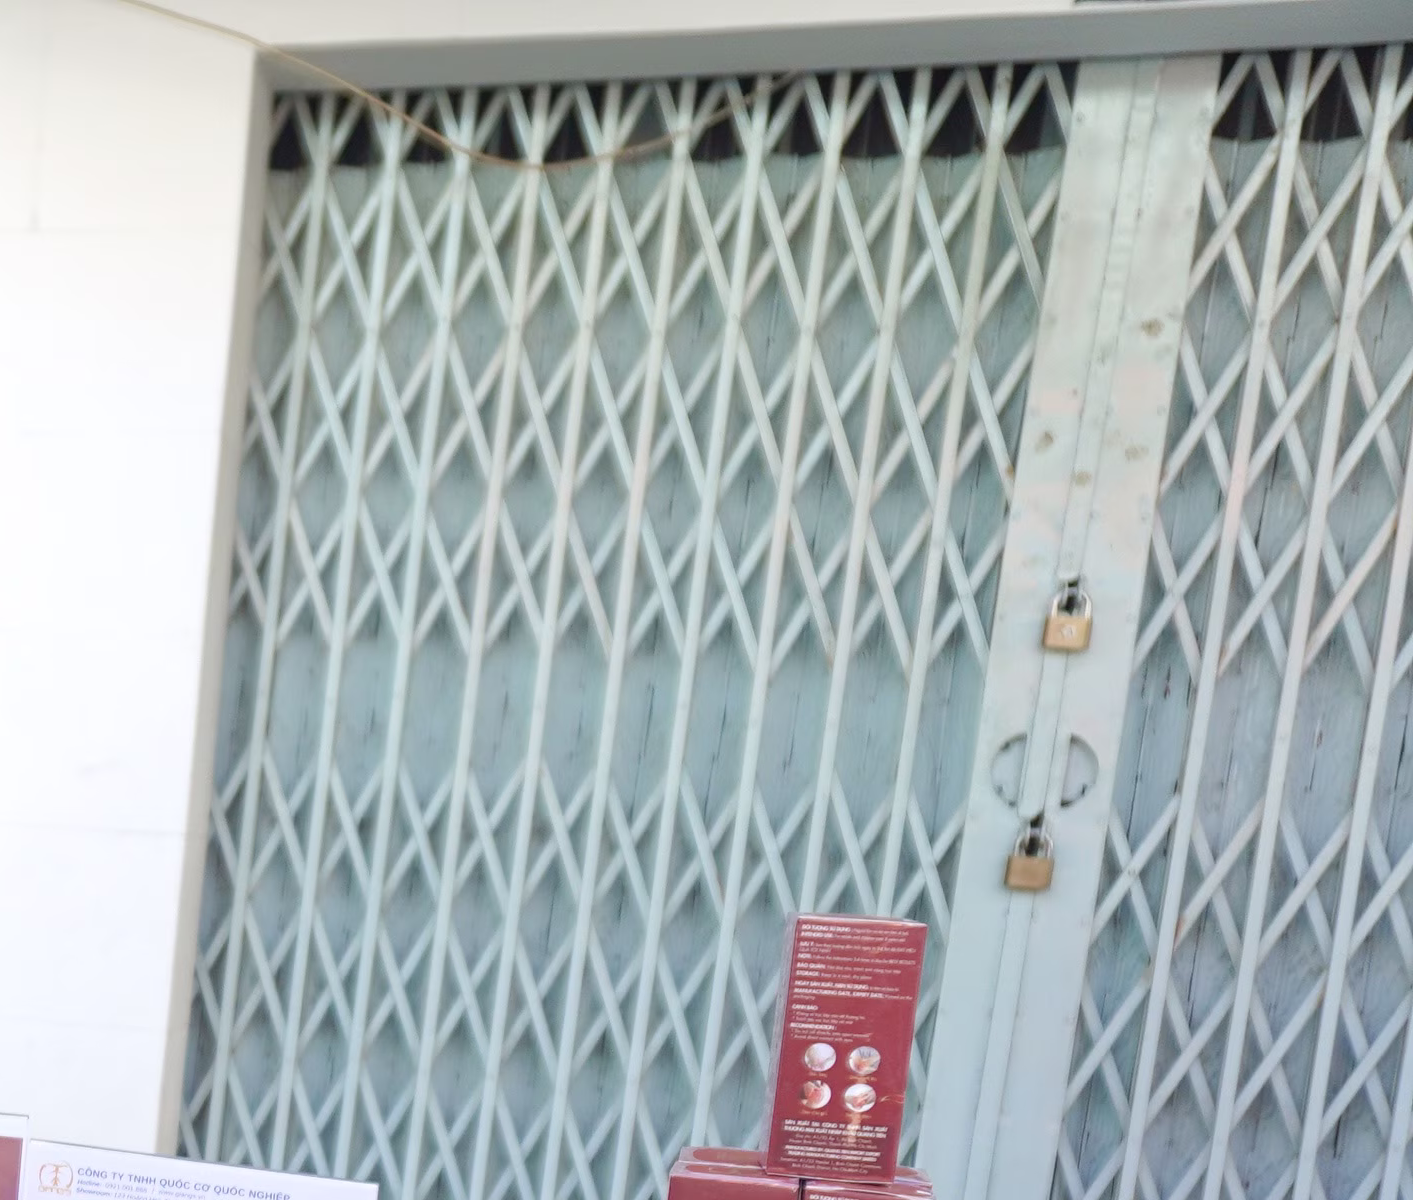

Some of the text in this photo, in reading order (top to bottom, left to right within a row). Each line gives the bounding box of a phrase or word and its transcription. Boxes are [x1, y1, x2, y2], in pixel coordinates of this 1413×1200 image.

[77, 1167, 108, 1179] CÔNG
[112, 1172, 124, 1181] TY
[128, 1174, 156, 1185] TNHH
[160, 1178, 190, 1190] QUỐC
[194, 1182, 211, 1192] CƠ
[214, 1184, 245, 1197] QUỐC
